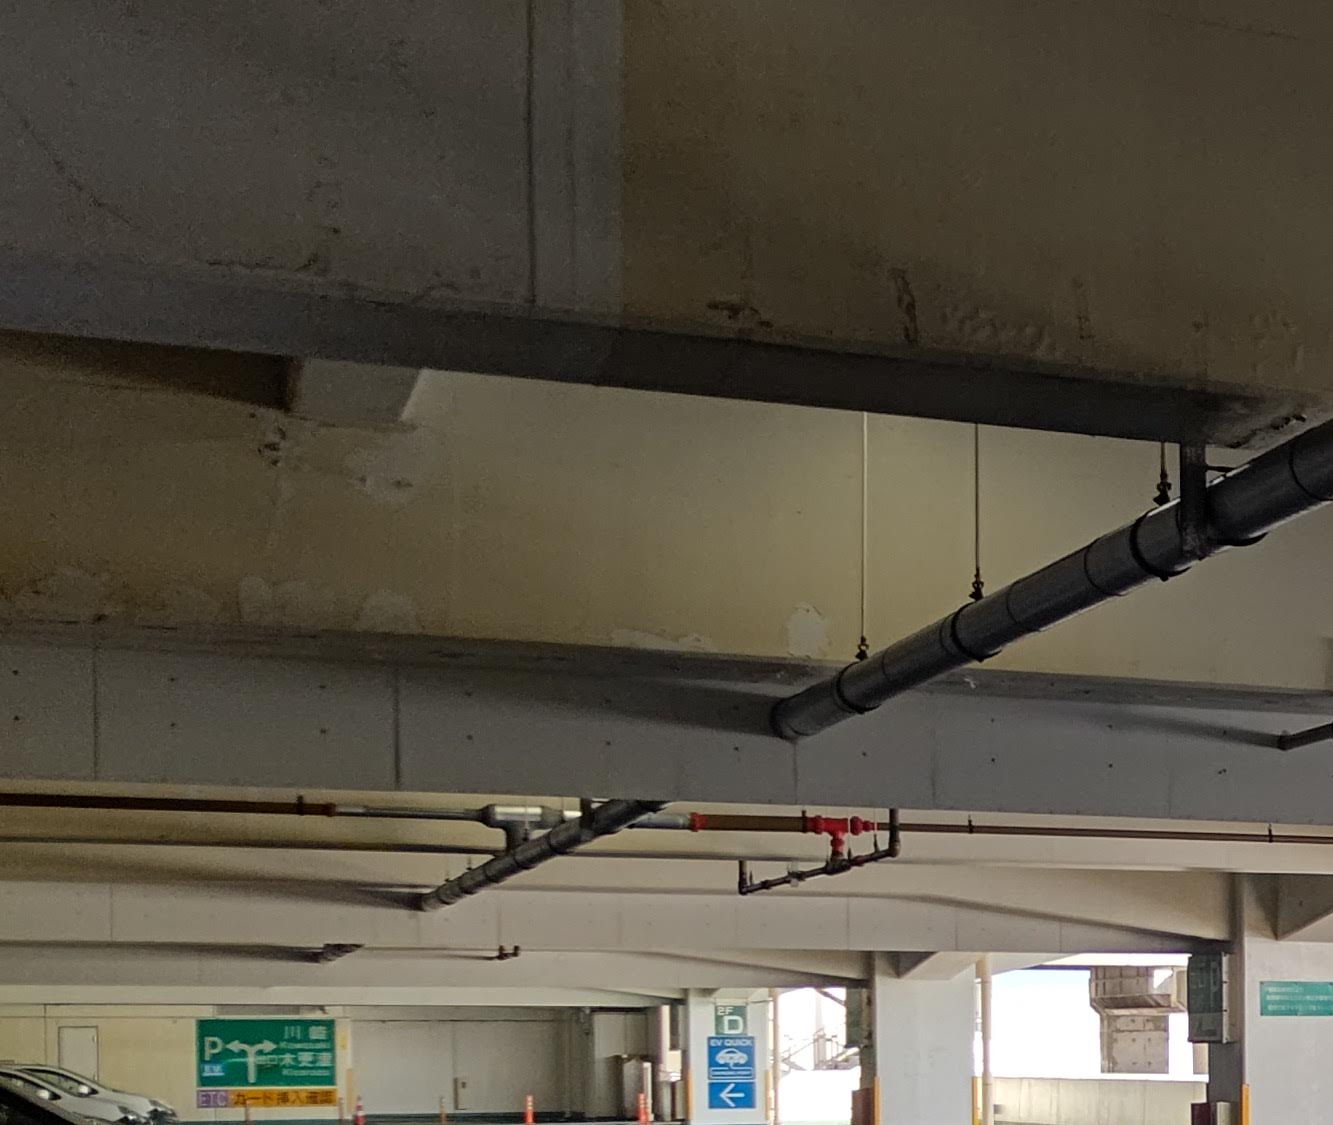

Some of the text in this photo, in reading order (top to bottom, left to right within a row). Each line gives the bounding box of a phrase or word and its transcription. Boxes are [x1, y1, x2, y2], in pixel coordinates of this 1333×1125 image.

[717, 1006, 734, 1015] 2F
[723, 1015, 744, 1034] D
[204, 1036, 224, 1061] P
[200, 1091, 227, 1105] ETC
